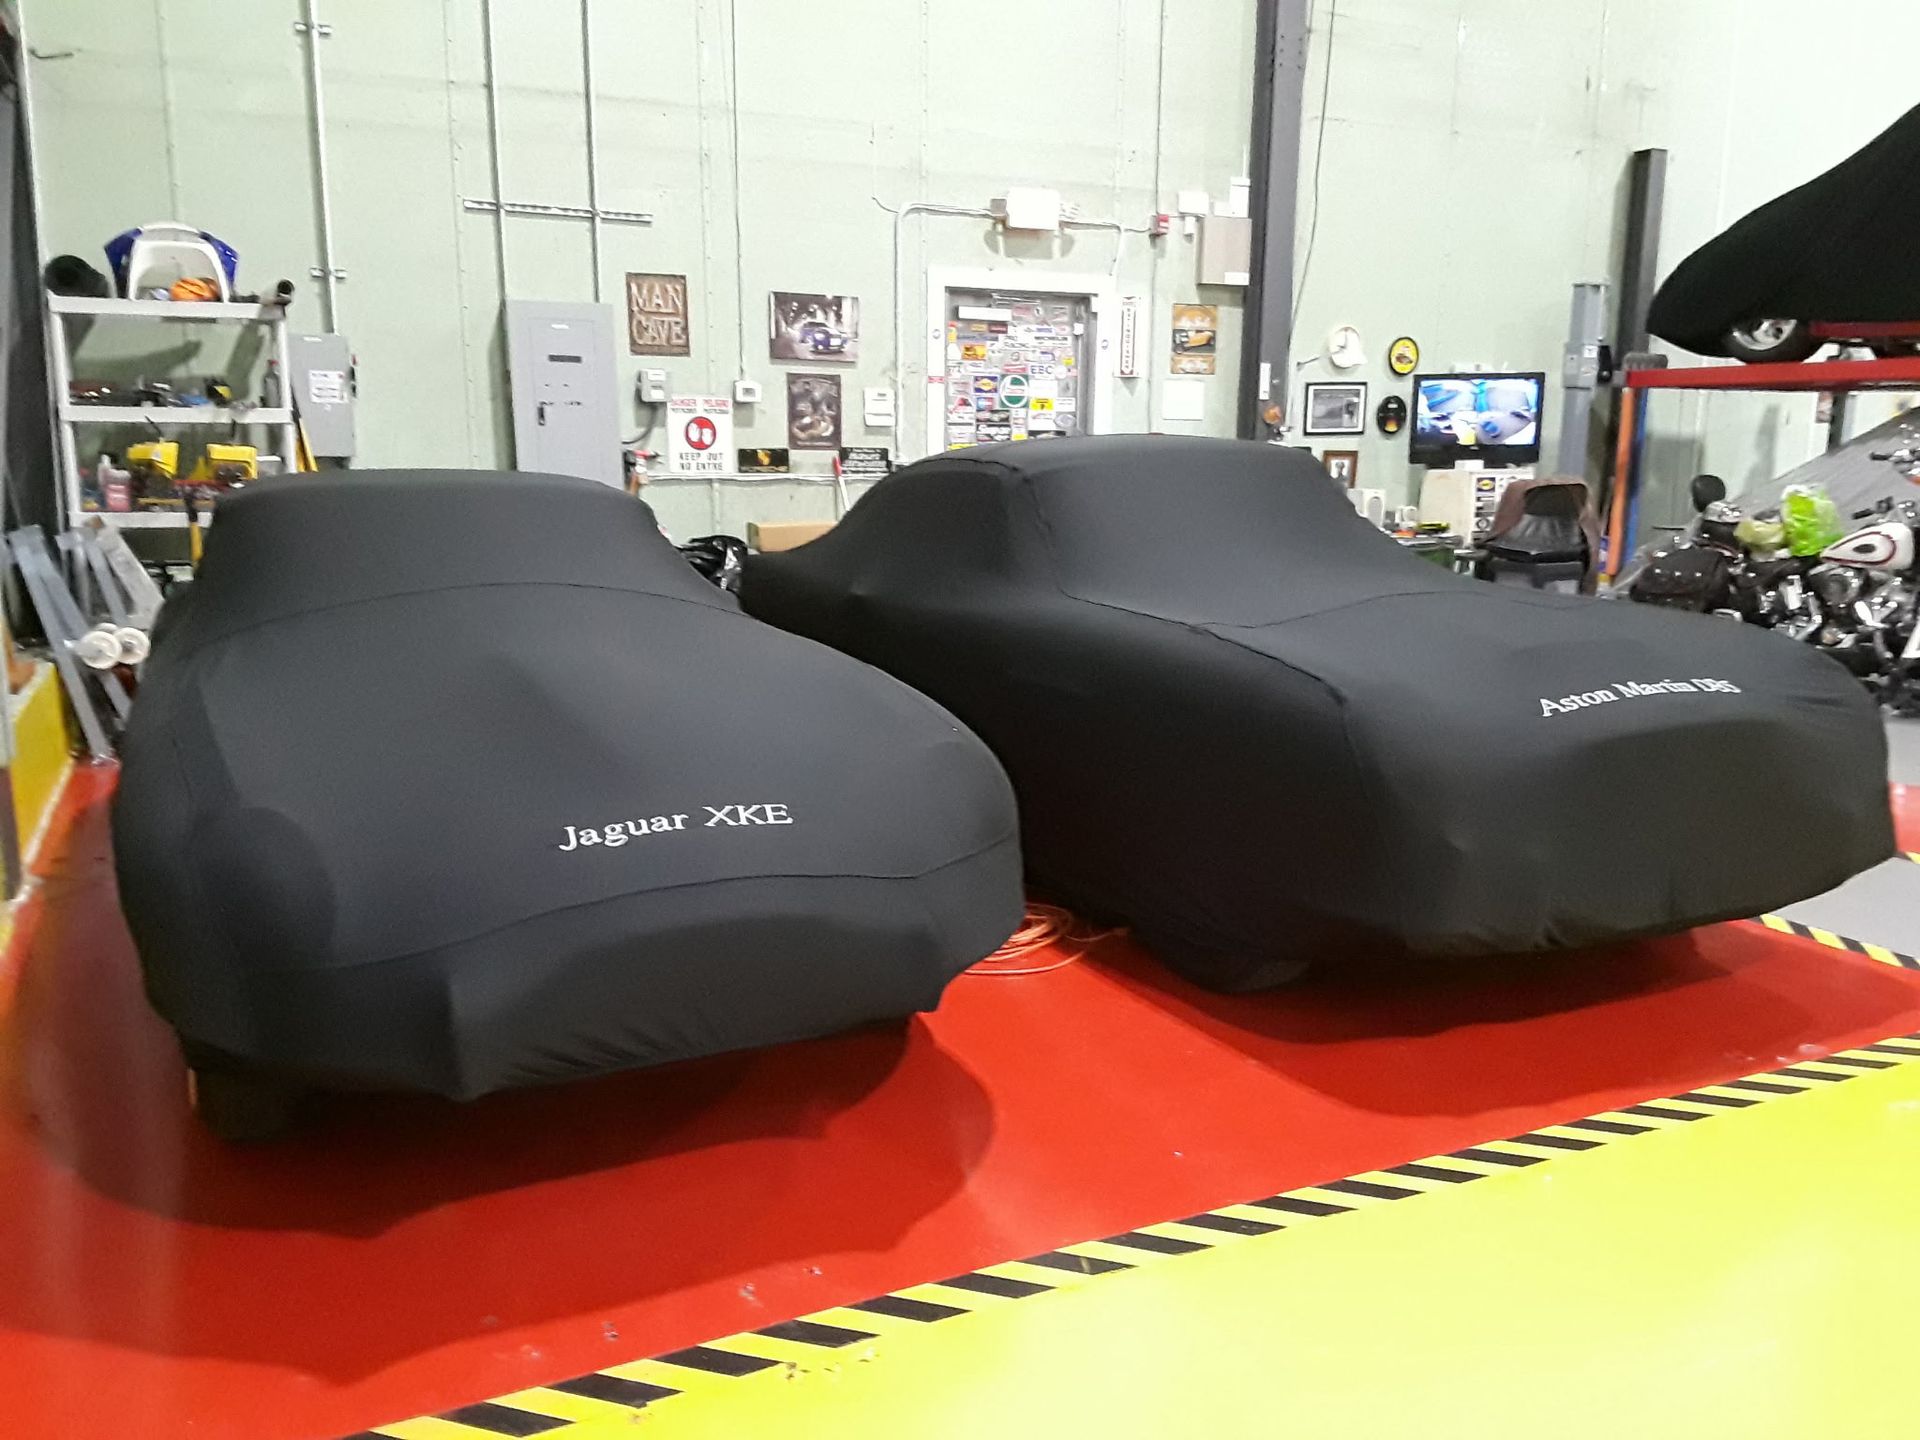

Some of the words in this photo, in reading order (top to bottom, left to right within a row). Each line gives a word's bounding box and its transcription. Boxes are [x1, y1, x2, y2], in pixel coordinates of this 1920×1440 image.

[630, 282, 683, 315] MAN
[631, 312, 687, 345] CAVE
[679, 452, 701, 461] KEEP
[707, 452, 723, 461] OUT
[680, 462, 691, 471] NO
[1539, 689, 1619, 717] Aston
[1611, 679, 1698, 698] Martin
[558, 812, 689, 851] Jaguar
[702, 803, 794, 827] XKE
